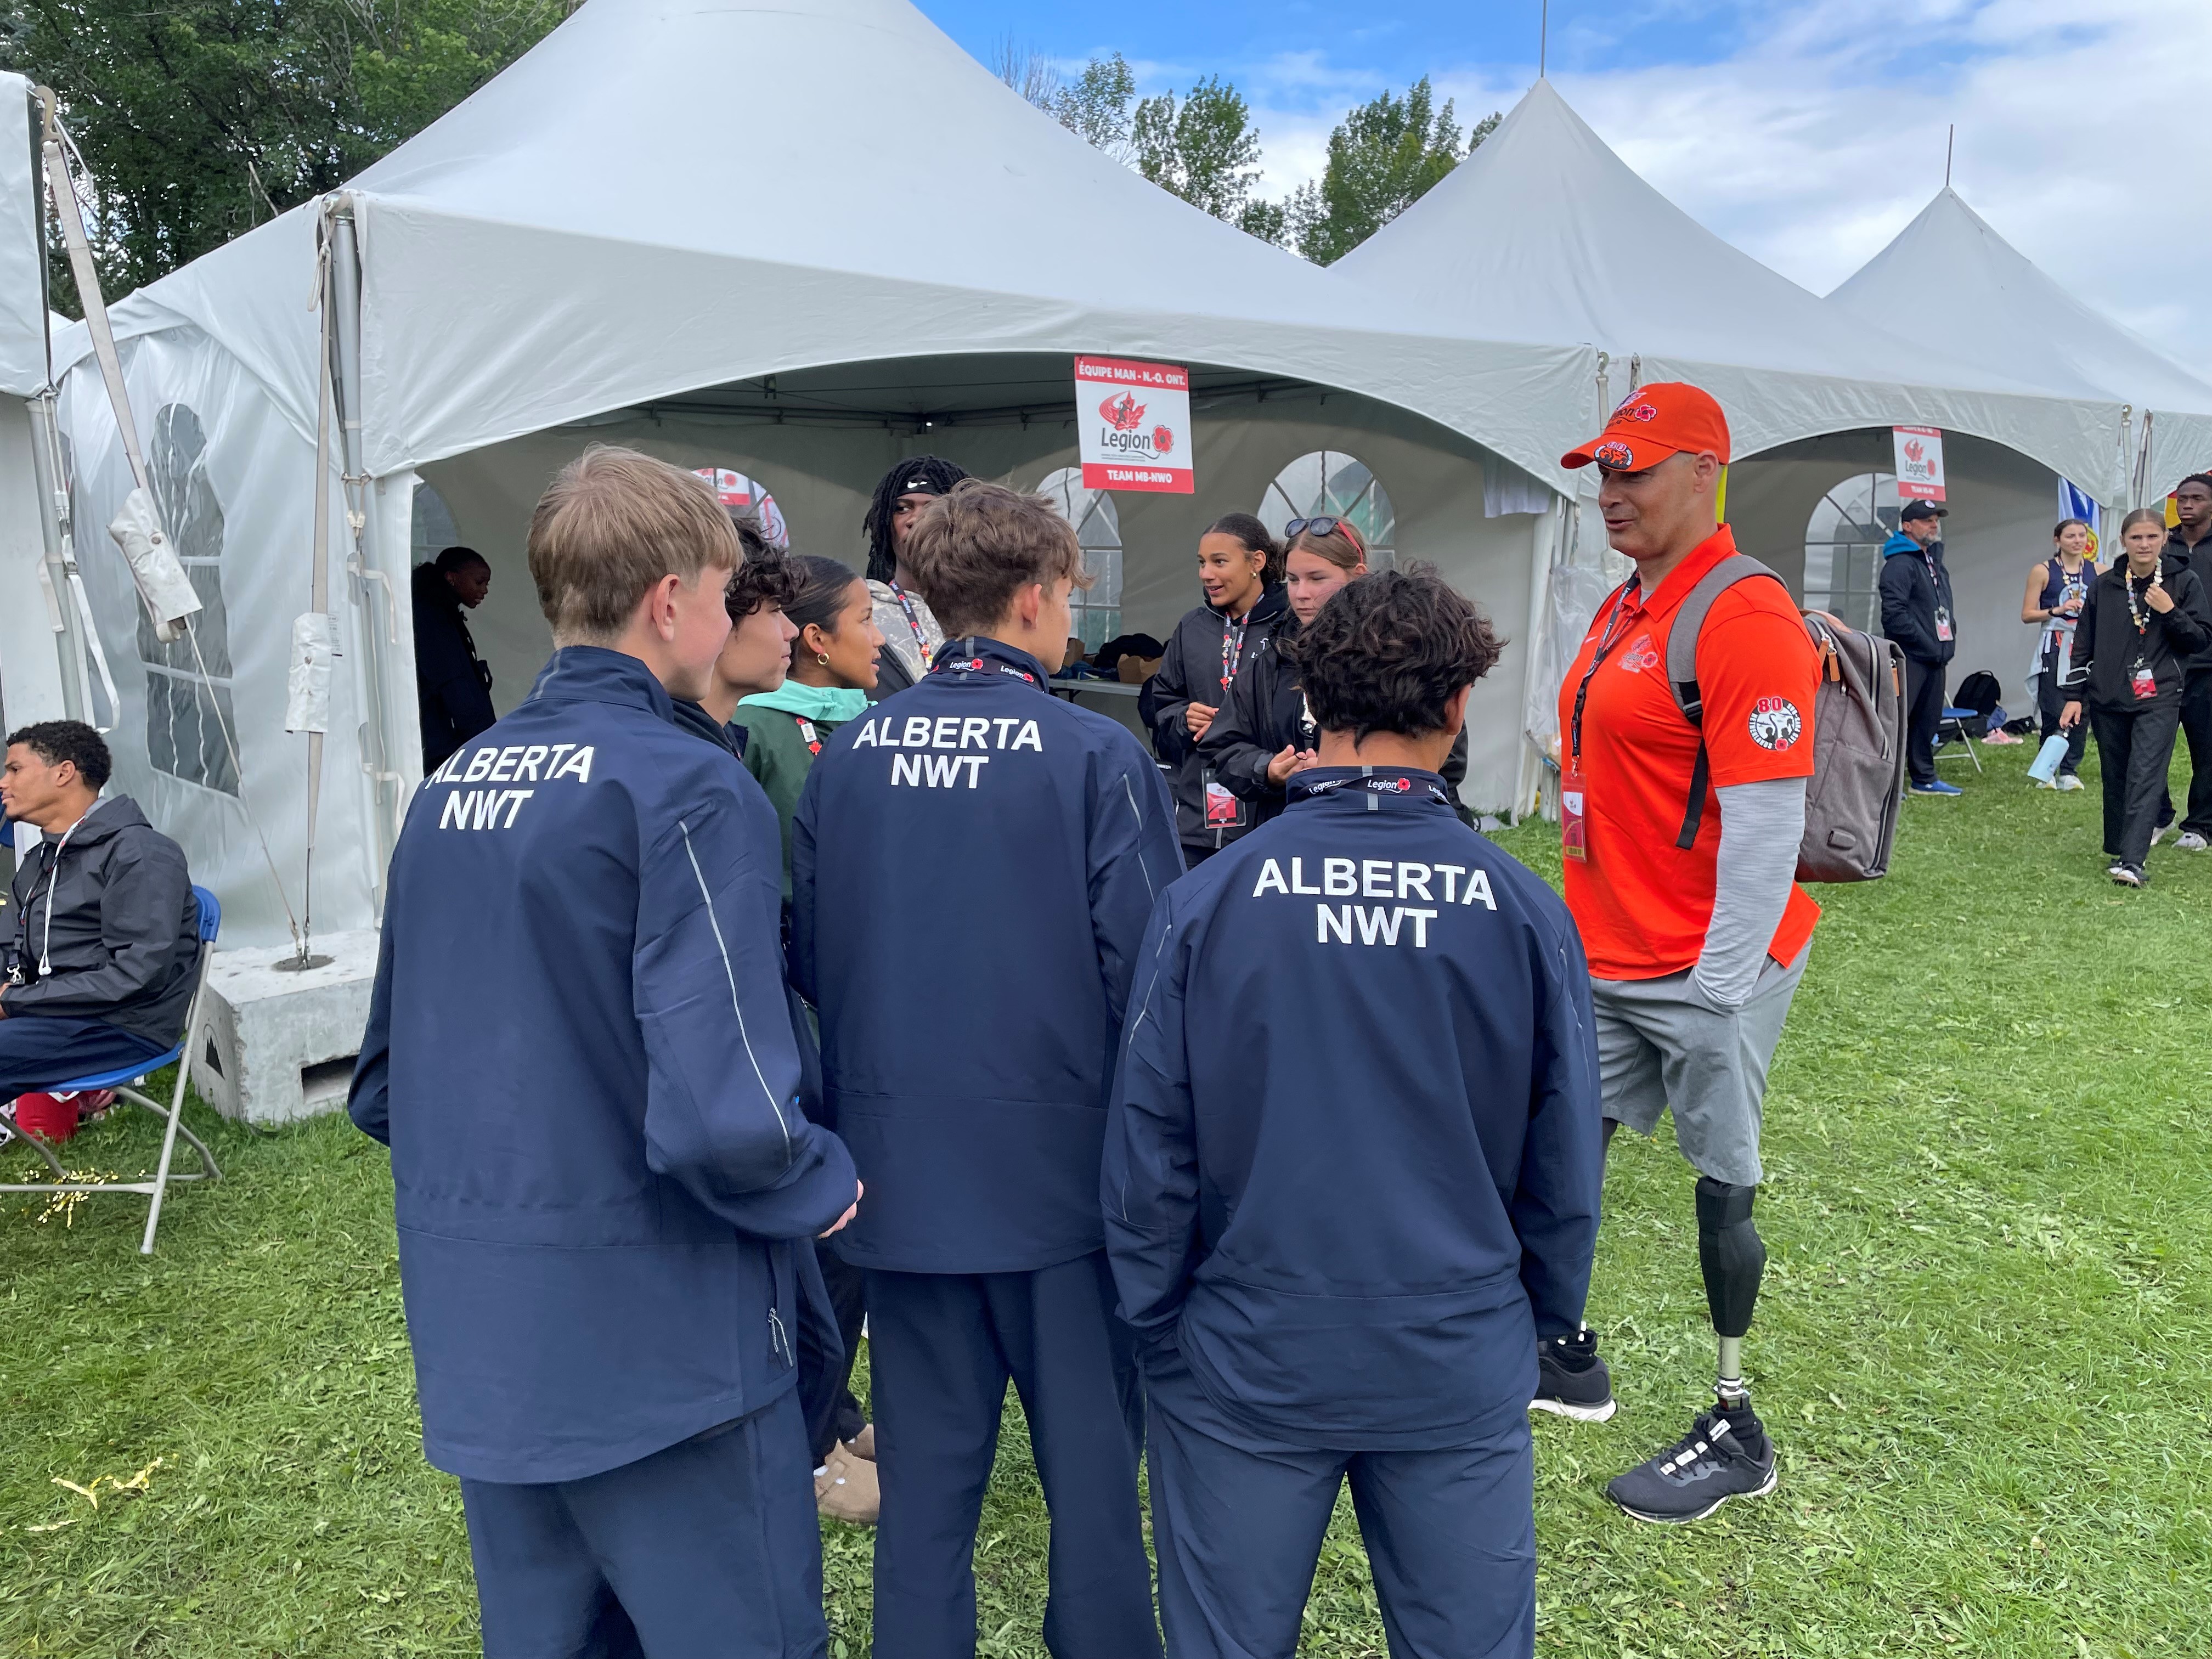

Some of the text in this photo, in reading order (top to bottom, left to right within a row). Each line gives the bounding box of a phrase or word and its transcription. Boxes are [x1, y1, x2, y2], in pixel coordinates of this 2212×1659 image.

[1079, 361, 1113, 378] ÉQUIPE
[1114, 368, 1136, 380] MAN
[1143, 372, 1164, 383] N.-O.
[1166, 375, 1186, 385] ONT.
[1101, 427, 1150, 453] Legion
[1107, 470, 1172, 483] TEAM MB-NWO
[1905, 460, 1927, 476] Legion
[950, 661, 971, 669] Legion
[1000, 665, 1024, 678] Legion
[1757, 696, 1783, 714] 80
[852, 716, 1042, 752] ALBERTA
[425, 743, 595, 790] ALBERTA
[891, 753, 989, 789] NWT
[1367, 779, 1397, 790] Legion
[439, 789, 534, 830] NWT
[1252, 856, 1498, 911] ALBERTA
[1317, 904, 1438, 948] NWT
